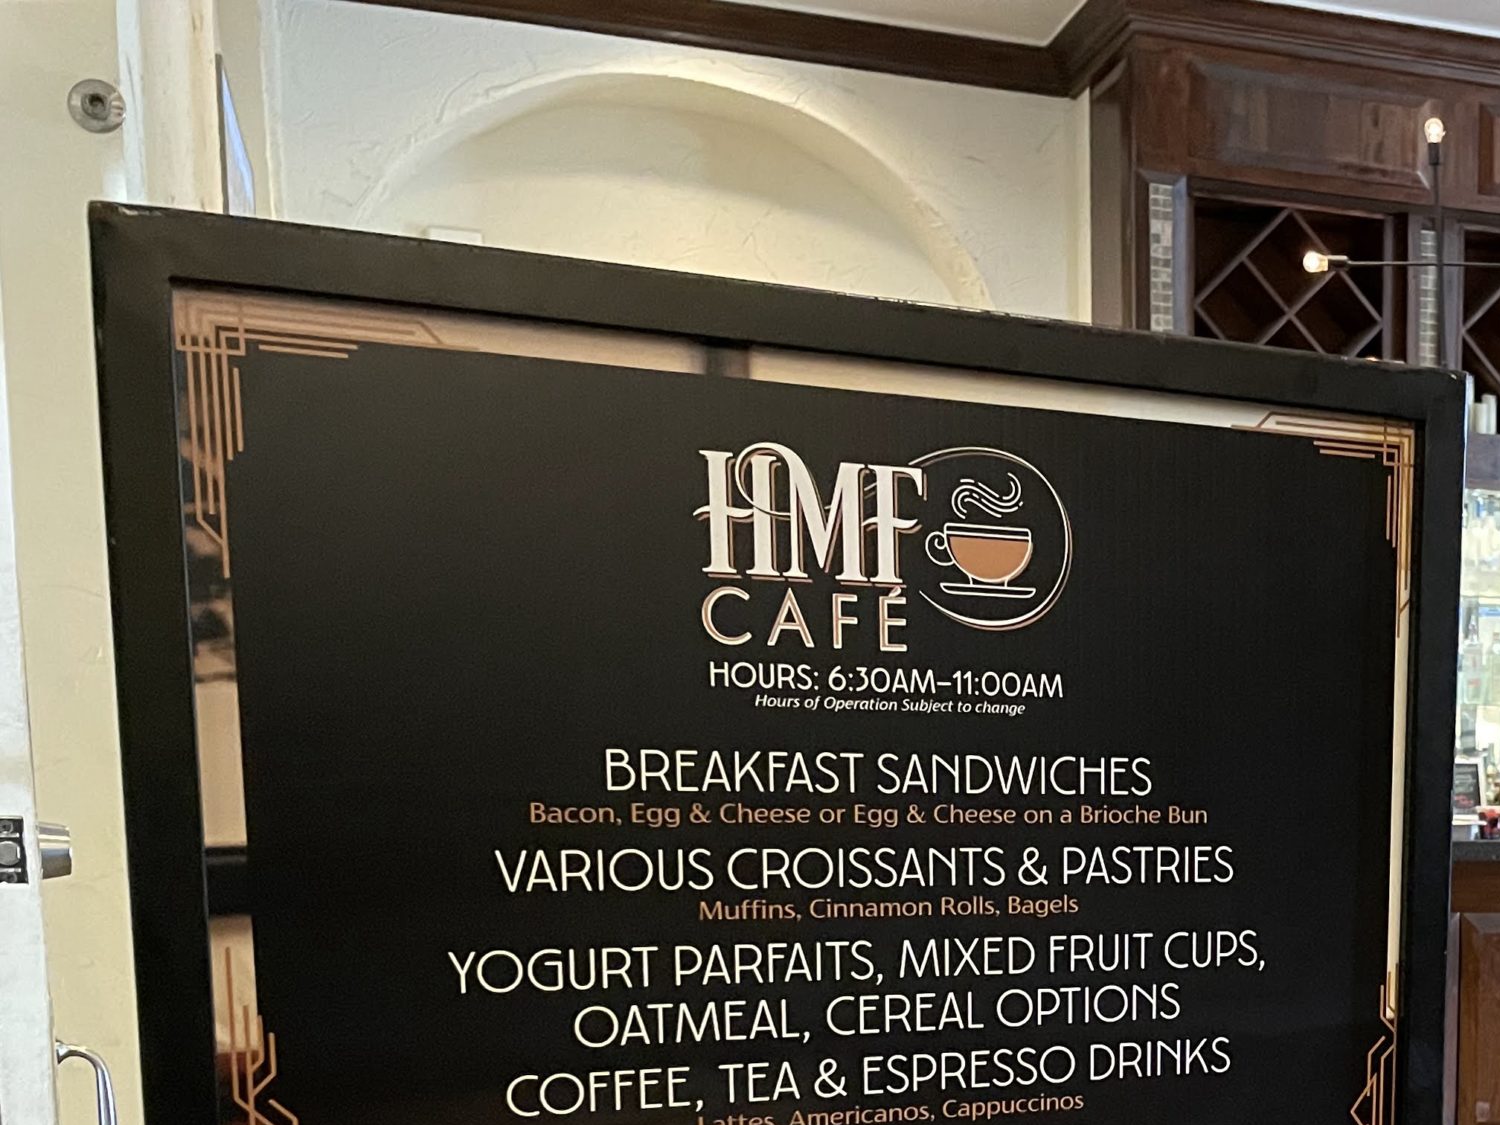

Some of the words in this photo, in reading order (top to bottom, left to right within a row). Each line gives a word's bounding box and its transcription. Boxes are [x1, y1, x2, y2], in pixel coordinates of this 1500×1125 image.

[700, 585, 909, 653] CAFÉ
[710, 661, 819, 690] HOURS:
[755, 694, 800, 708] Hours
[804, 696, 821, 710] of
[824, 697, 897, 712] Operation
[901, 699, 954, 713] Subject
[957, 701, 972, 712] to
[975, 701, 1025, 716] change
[605, 749, 864, 793] BREAKFAST
[877, 753, 1152, 796] SANDWICHES
[530, 802, 622, 825] Bacon,
[631, 803, 680, 827] Egg
[689, 803, 711, 823] &
[720, 803, 811, 823] Cheese
[819, 809, 846, 823] or
[854, 804, 898, 827] Egg
[907, 804, 926, 823] &
[934, 804, 1016, 823] Cheese
[1024, 810, 1052, 824] on
[1060, 810, 1072, 823] a
[1081, 805, 1161, 823] Brioche
[1169, 806, 1207, 824] Bun
[494, 848, 714, 892] VARIOUS
[727, 847, 1005, 890] CROISSANTS
[1018, 847, 1048, 886] &
[1063, 846, 1233, 884] PASTRIES
[700, 899, 801, 921] Muffins,
[810, 898, 932, 918] Cinnamon
[941, 896, 1000, 916] Rolls,
[1008, 894, 1078, 917] Bagels
[448, 946, 659, 994] YOGURT
[675, 940, 883, 986] PARFAITS,
[900, 937, 1035, 978] MIXED
[1050, 933, 1153, 973] FRUIT
[1165, 930, 1265, 971] CUPS,
[574, 999, 810, 1047] OATMEAL,
[827, 991, 984, 1035] CEREAL
[996, 983, 1180, 1027] OPTIONS
[506, 1066, 703, 1117] COFFEE,
[718, 1061, 800, 1103] TEA
[814, 1058, 847, 1098] &
[863, 1046, 1075, 1095] ESPRESSO
[1090, 1037, 1230, 1080] DRINKS
[943, 1093, 1084, 1121] Cappuccinos
